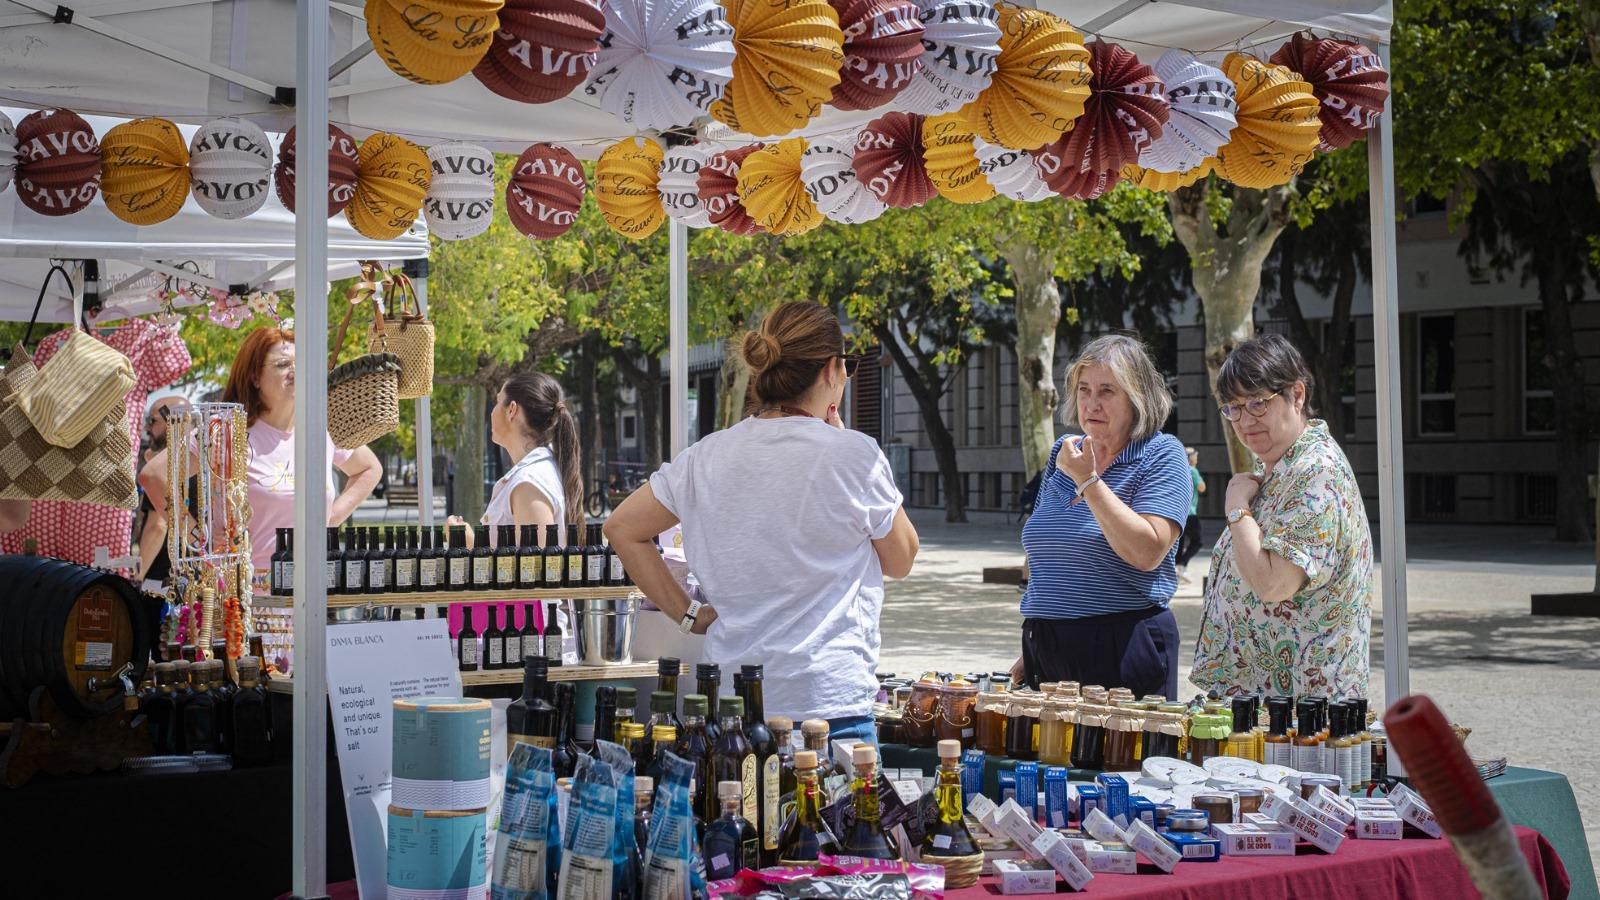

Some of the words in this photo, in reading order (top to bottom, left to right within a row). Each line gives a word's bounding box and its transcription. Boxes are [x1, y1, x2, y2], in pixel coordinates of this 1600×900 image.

[331, 638, 353, 647] DAMA
[354, 635, 384, 645] BLANCA
[339, 685, 366, 695] Natural,
[341, 697, 375, 709] ecological
[343, 714, 356, 723] and
[345, 725, 367, 736] That's
[367, 726, 378, 734] our
[347, 741, 360, 751] salt
